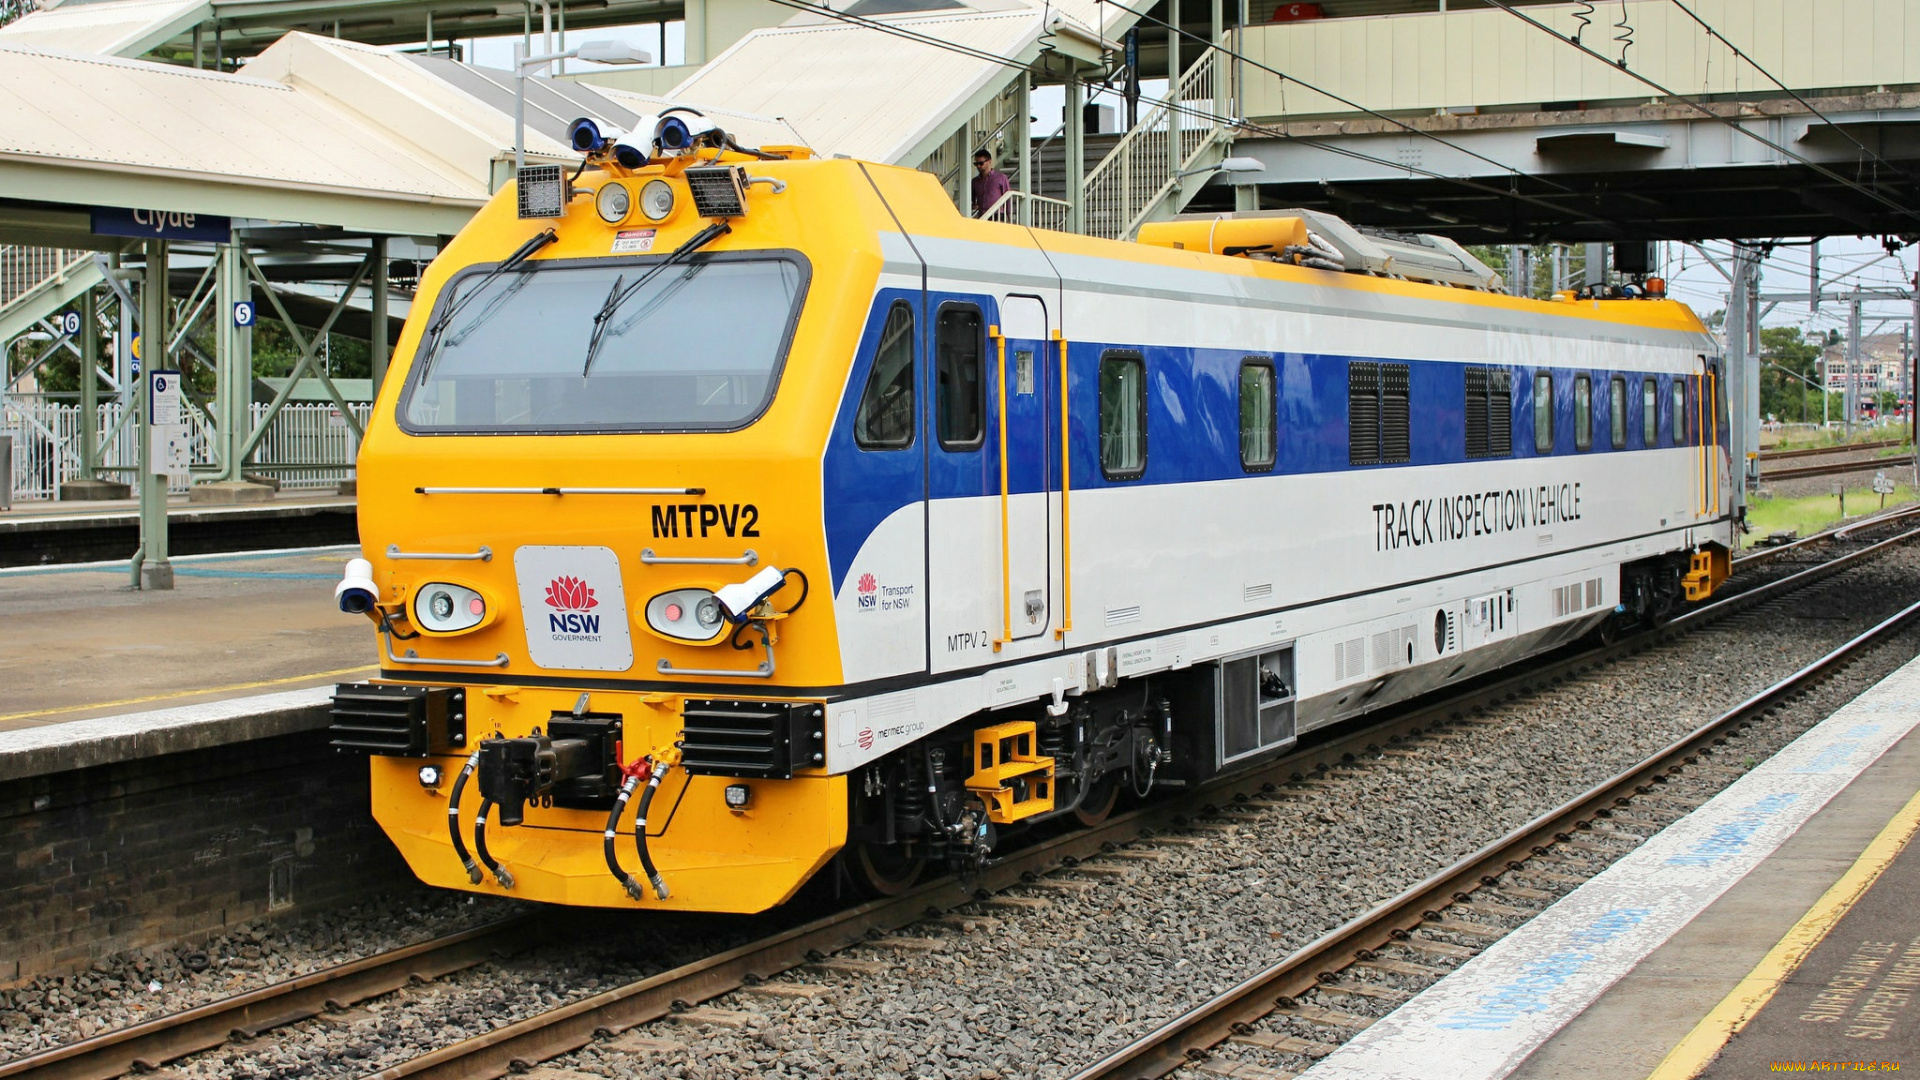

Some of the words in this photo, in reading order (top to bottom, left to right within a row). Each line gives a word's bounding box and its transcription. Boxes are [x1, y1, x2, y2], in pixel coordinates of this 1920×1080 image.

[133, 207, 196, 233] Clyde
[240, 307, 247, 321] 5
[69, 316, 76, 330] 6
[651, 504, 760, 538] MTPV2
[1372, 499, 1433, 552] TRACK
[1439, 489, 1526, 542] INSPECTION
[1529, 482, 1581, 527] VEHICLE
[881, 584, 914, 597] Transport
[858, 595, 877, 608] NSW
[881, 599, 892, 611] for
[893, 598, 910, 609] NSW
[549, 614, 600, 634] NSW
[552, 634, 602, 643] GOVERNMENT
[947, 631, 978, 652] MTPV
[981, 630, 987, 647] 2
[904, 721, 925, 736] group
[1799, 974, 1871, 1022] SURFACE
[1859, 940, 1899, 955] BE
